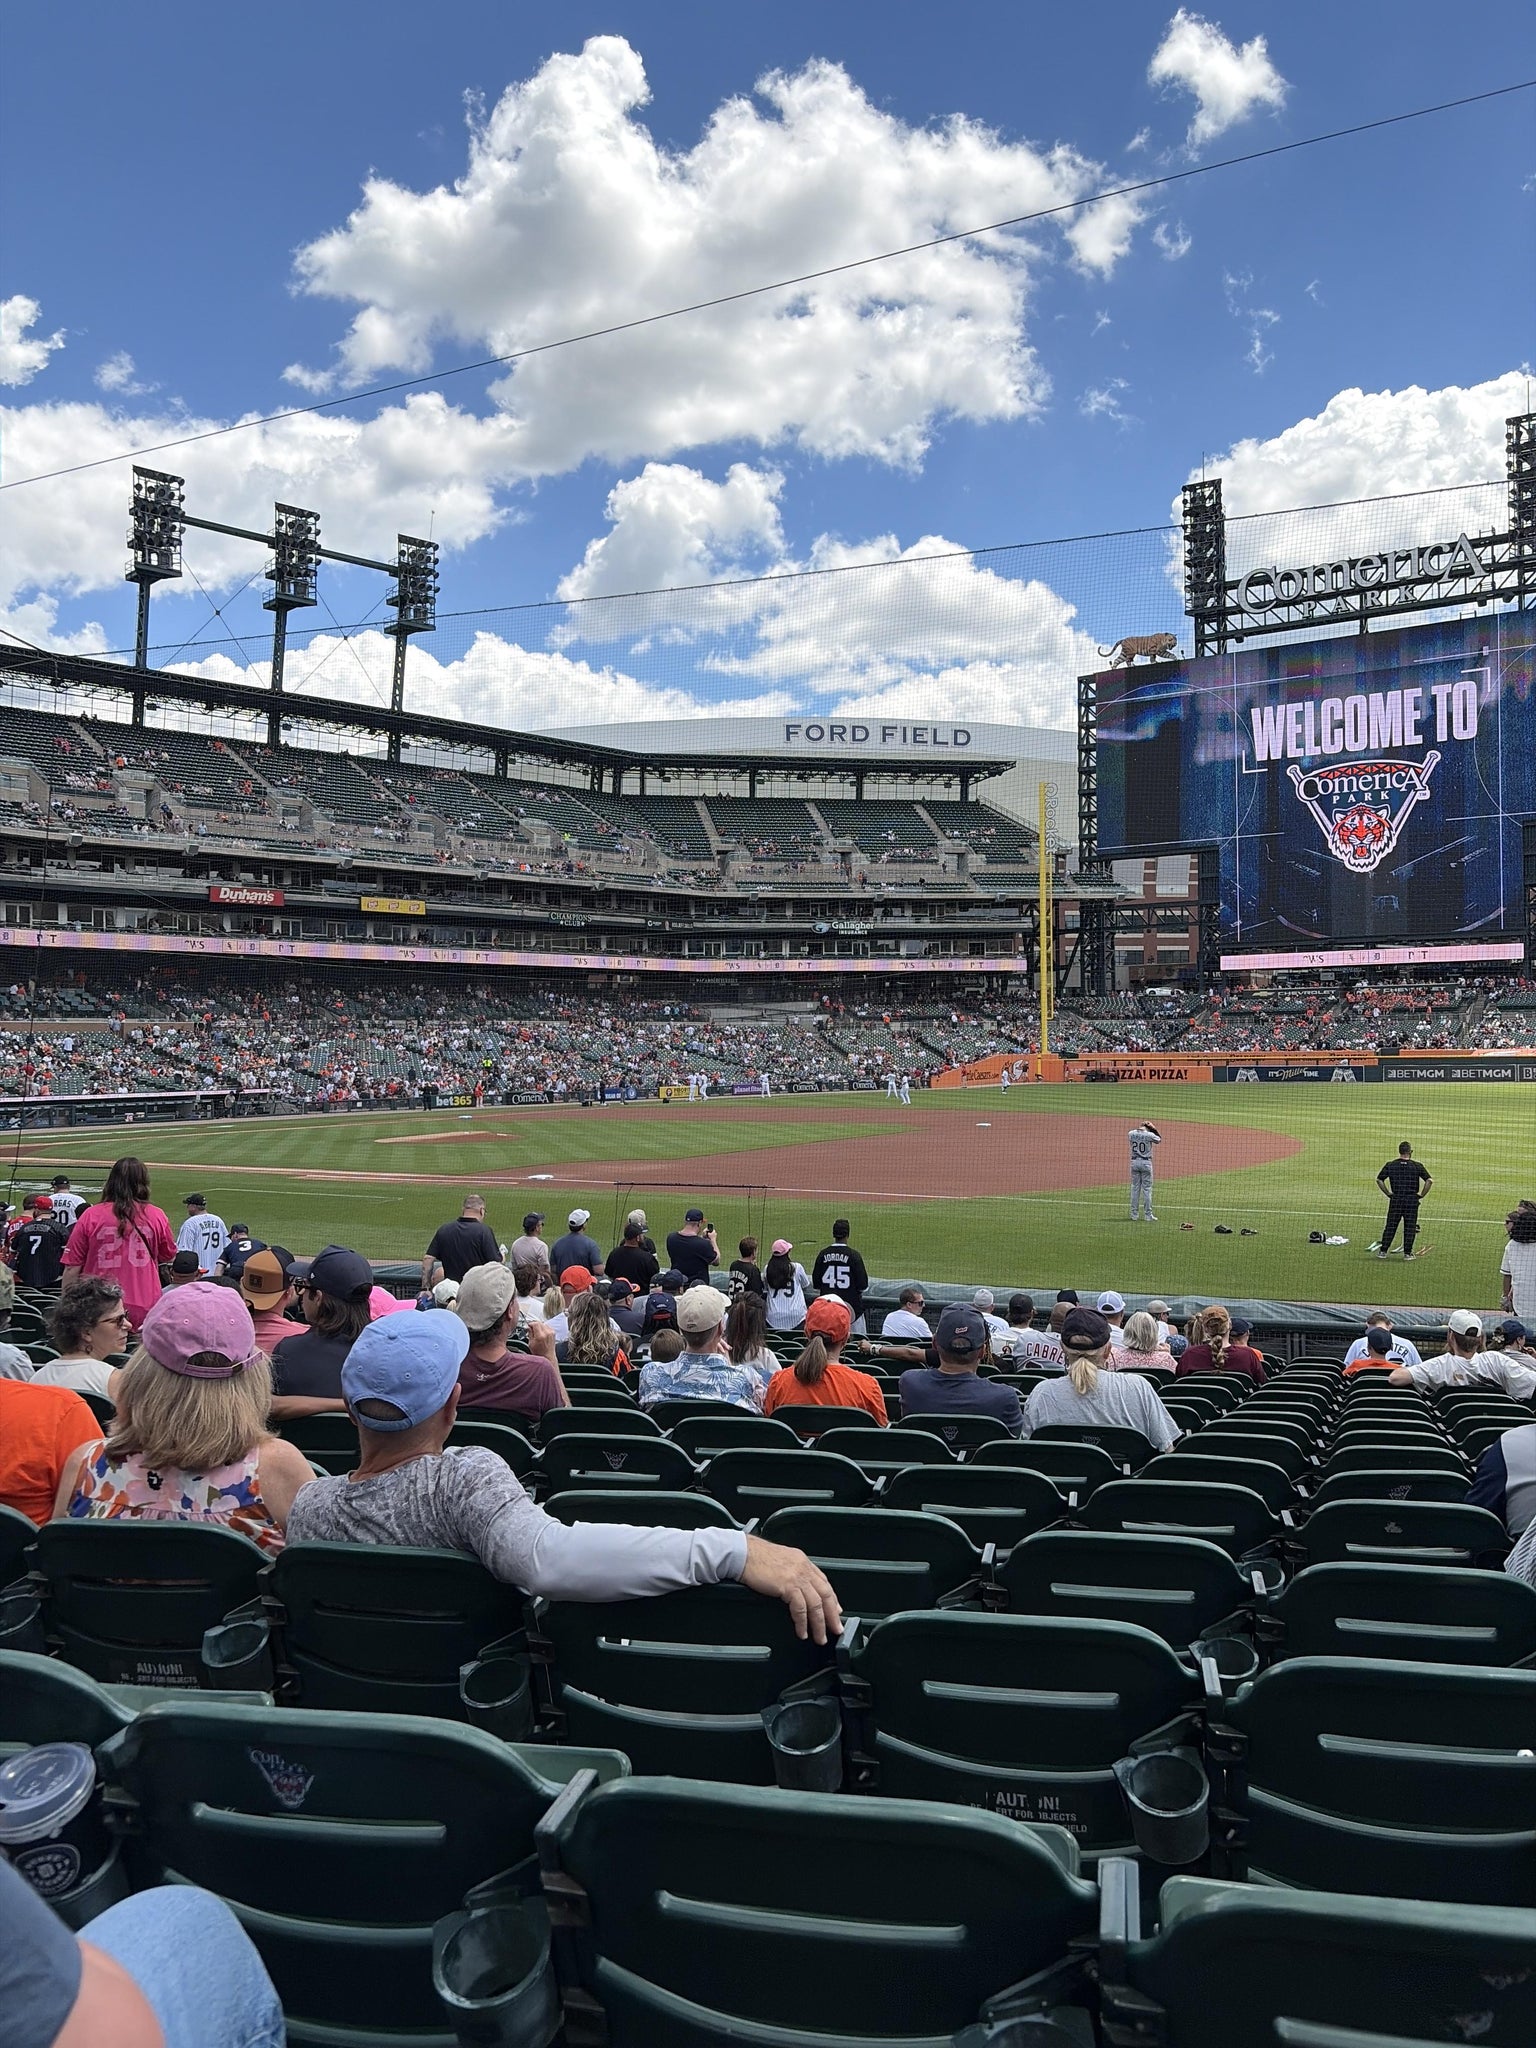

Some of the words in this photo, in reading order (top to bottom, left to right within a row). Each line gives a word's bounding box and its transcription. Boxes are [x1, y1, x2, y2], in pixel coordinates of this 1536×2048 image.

[1302, 585, 1418, 619] PARK
[1251, 687, 1423, 761] WELCOME
[1431, 680, 1478, 742] TO
[785, 724, 870, 743] FORD
[881, 725, 972, 746] FIELD
[1332, 790, 1390, 804] PARK
[1045, 797, 1059, 855] Rocket
[219, 887, 275, 902] Dunham's
[550, 912, 592, 922] CHAMPIONS
[831, 921, 875, 931] Gallagher
[1277, 989, 1337, 998] CHEVROLET
[1115, 1069, 1146, 1080] IZZA!
[1149, 1069, 1188, 1080] PIZZA!
[1280, 1067, 1308, 1080] Miller
[1303, 1070, 1320, 1078] TIME
[1396, 1069, 1445, 1078] BETMGM
[1461, 1069, 1512, 1078] BETMGM
[734, 1084, 750, 1094] planet
[436, 1095, 473, 1107] bet365
[1132, 1141, 1146, 1153] 20
[29, 1235, 42, 1255] 7
[202, 1231, 220, 1250] 79
[238, 1240, 252, 1252] 3
[97, 1226, 154, 1269] 26
[823, 1252, 849, 1264] JORDAN
[821, 1265, 851, 1289] 45
[1015, 1809, 1034, 1820] FOR
